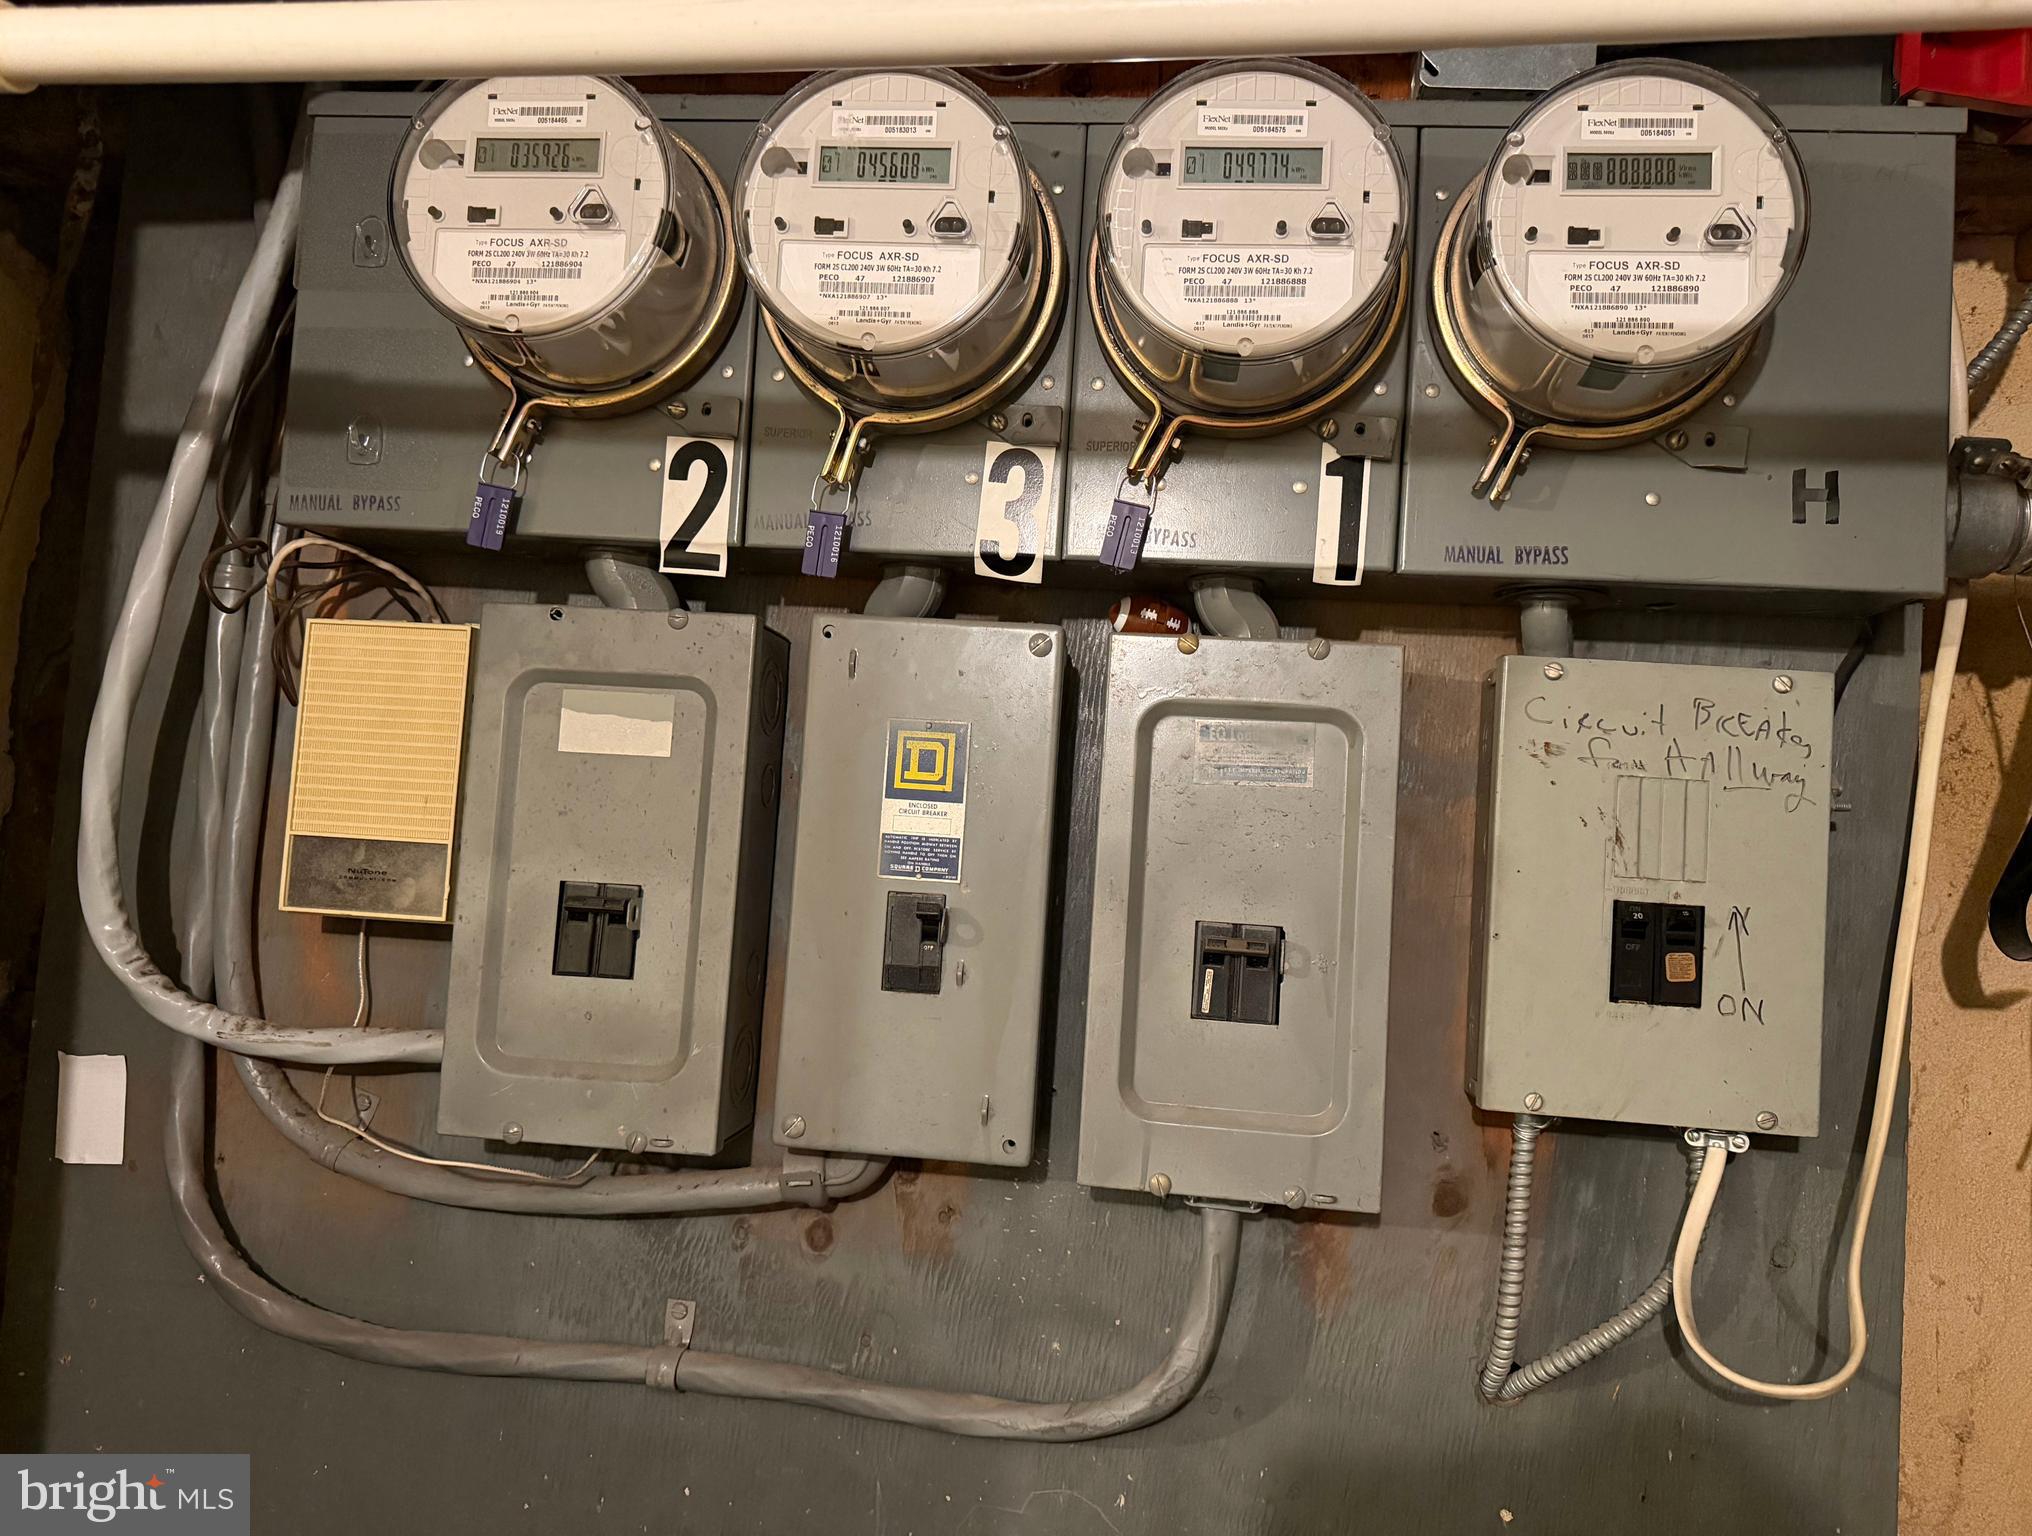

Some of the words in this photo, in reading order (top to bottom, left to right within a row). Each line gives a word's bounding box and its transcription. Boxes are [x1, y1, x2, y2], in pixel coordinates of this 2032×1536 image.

[1588, 119, 1617, 127] FlexNet
[511, 143, 570, 168] 035926
[857, 152, 920, 179] 045608
[1223, 152, 1289, 179] 049774
[490, 238, 524, 246] FOCUS
[530, 238, 568, 247] AXR-SD
[837, 251, 873, 260] FOCUS
[879, 252, 919, 261] AXR-SD
[1202, 254, 1240, 263] FOCUS
[1247, 254, 1289, 263] AXR-SD
[1589, 261, 1628, 270] FOCUS
[1636, 261, 1680, 270] AXR-SD
[1086, 440, 1137, 452] SUPERIOR
[290, 494, 342, 511] MANUAL
[352, 494, 401, 511] BYPASS
[472, 496, 483, 519] PECO
[664, 440, 728, 572] 2
[1792, 468, 1840, 525] H
[495, 498, 511, 535] 1210019
[980, 447, 1045, 577] 3
[1325, 455, 1365, 581] 1
[806, 525, 815, 548] PECO
[1107, 514, 1118, 537] PECO
[1130, 517, 1145, 554] 1210013
[831, 525, 843, 563] 1210016
[1444, 545, 1504, 564] MANUAL
[1515, 545, 1569, 565] BYPASS
[904, 740, 946, 782] D
[908, 802, 938, 810] ENCLOSED
[922, 809, 948, 817] BREAKER
[347, 868, 388, 876] NuTone
[1632, 912, 1644, 920] 20
[1717, 993, 1765, 1026] ON
